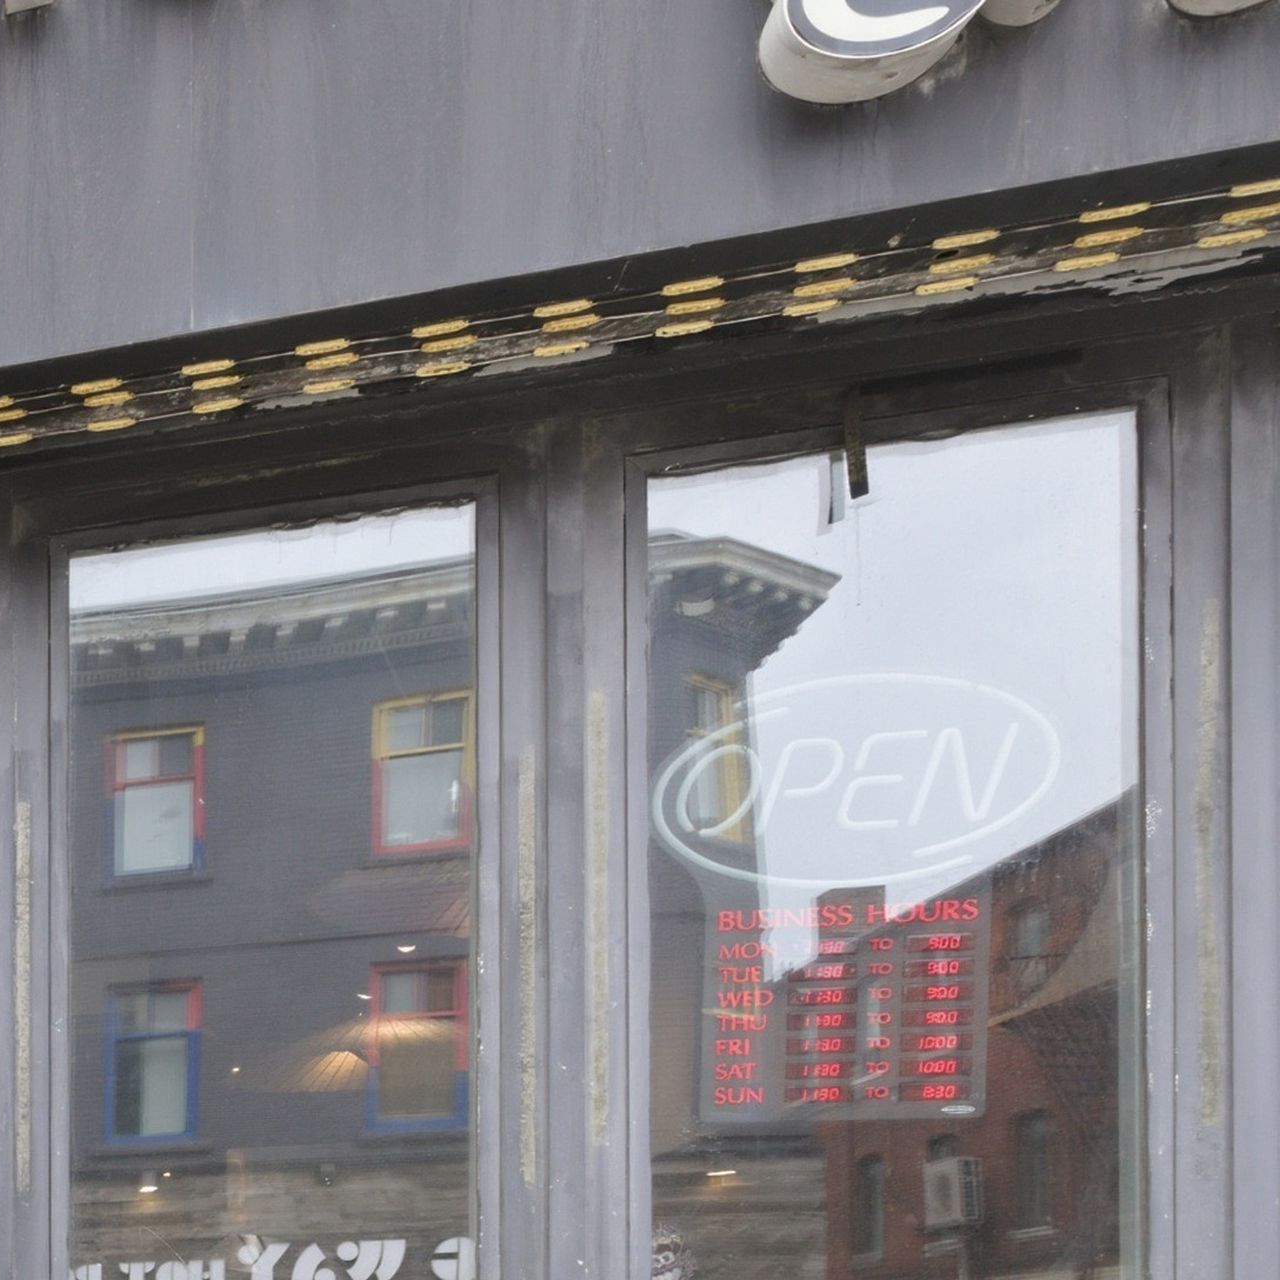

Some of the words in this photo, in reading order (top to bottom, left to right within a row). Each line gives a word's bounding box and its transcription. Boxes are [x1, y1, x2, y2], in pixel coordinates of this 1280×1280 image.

[676, 721, 1019, 840] OPEN
[717, 903, 855, 931] BUSINESS
[866, 899, 980, 924] HOURS
[869, 938, 894, 950] TO
[719, 966, 762, 983] TUE
[869, 963, 894, 975] TO
[717, 990, 774, 1007] WED
[868, 988, 893, 998] TO
[717, 1014, 768, 1031] THU
[867, 1012, 892, 1024] TO
[714, 1038, 751, 1056] FRI
[866, 1037, 891, 1048] TO
[714, 1062, 757, 1081] SAT
[866, 1062, 889, 1073] TO
[714, 1087, 765, 1105] SUN
[865, 1086, 889, 1098] TO
